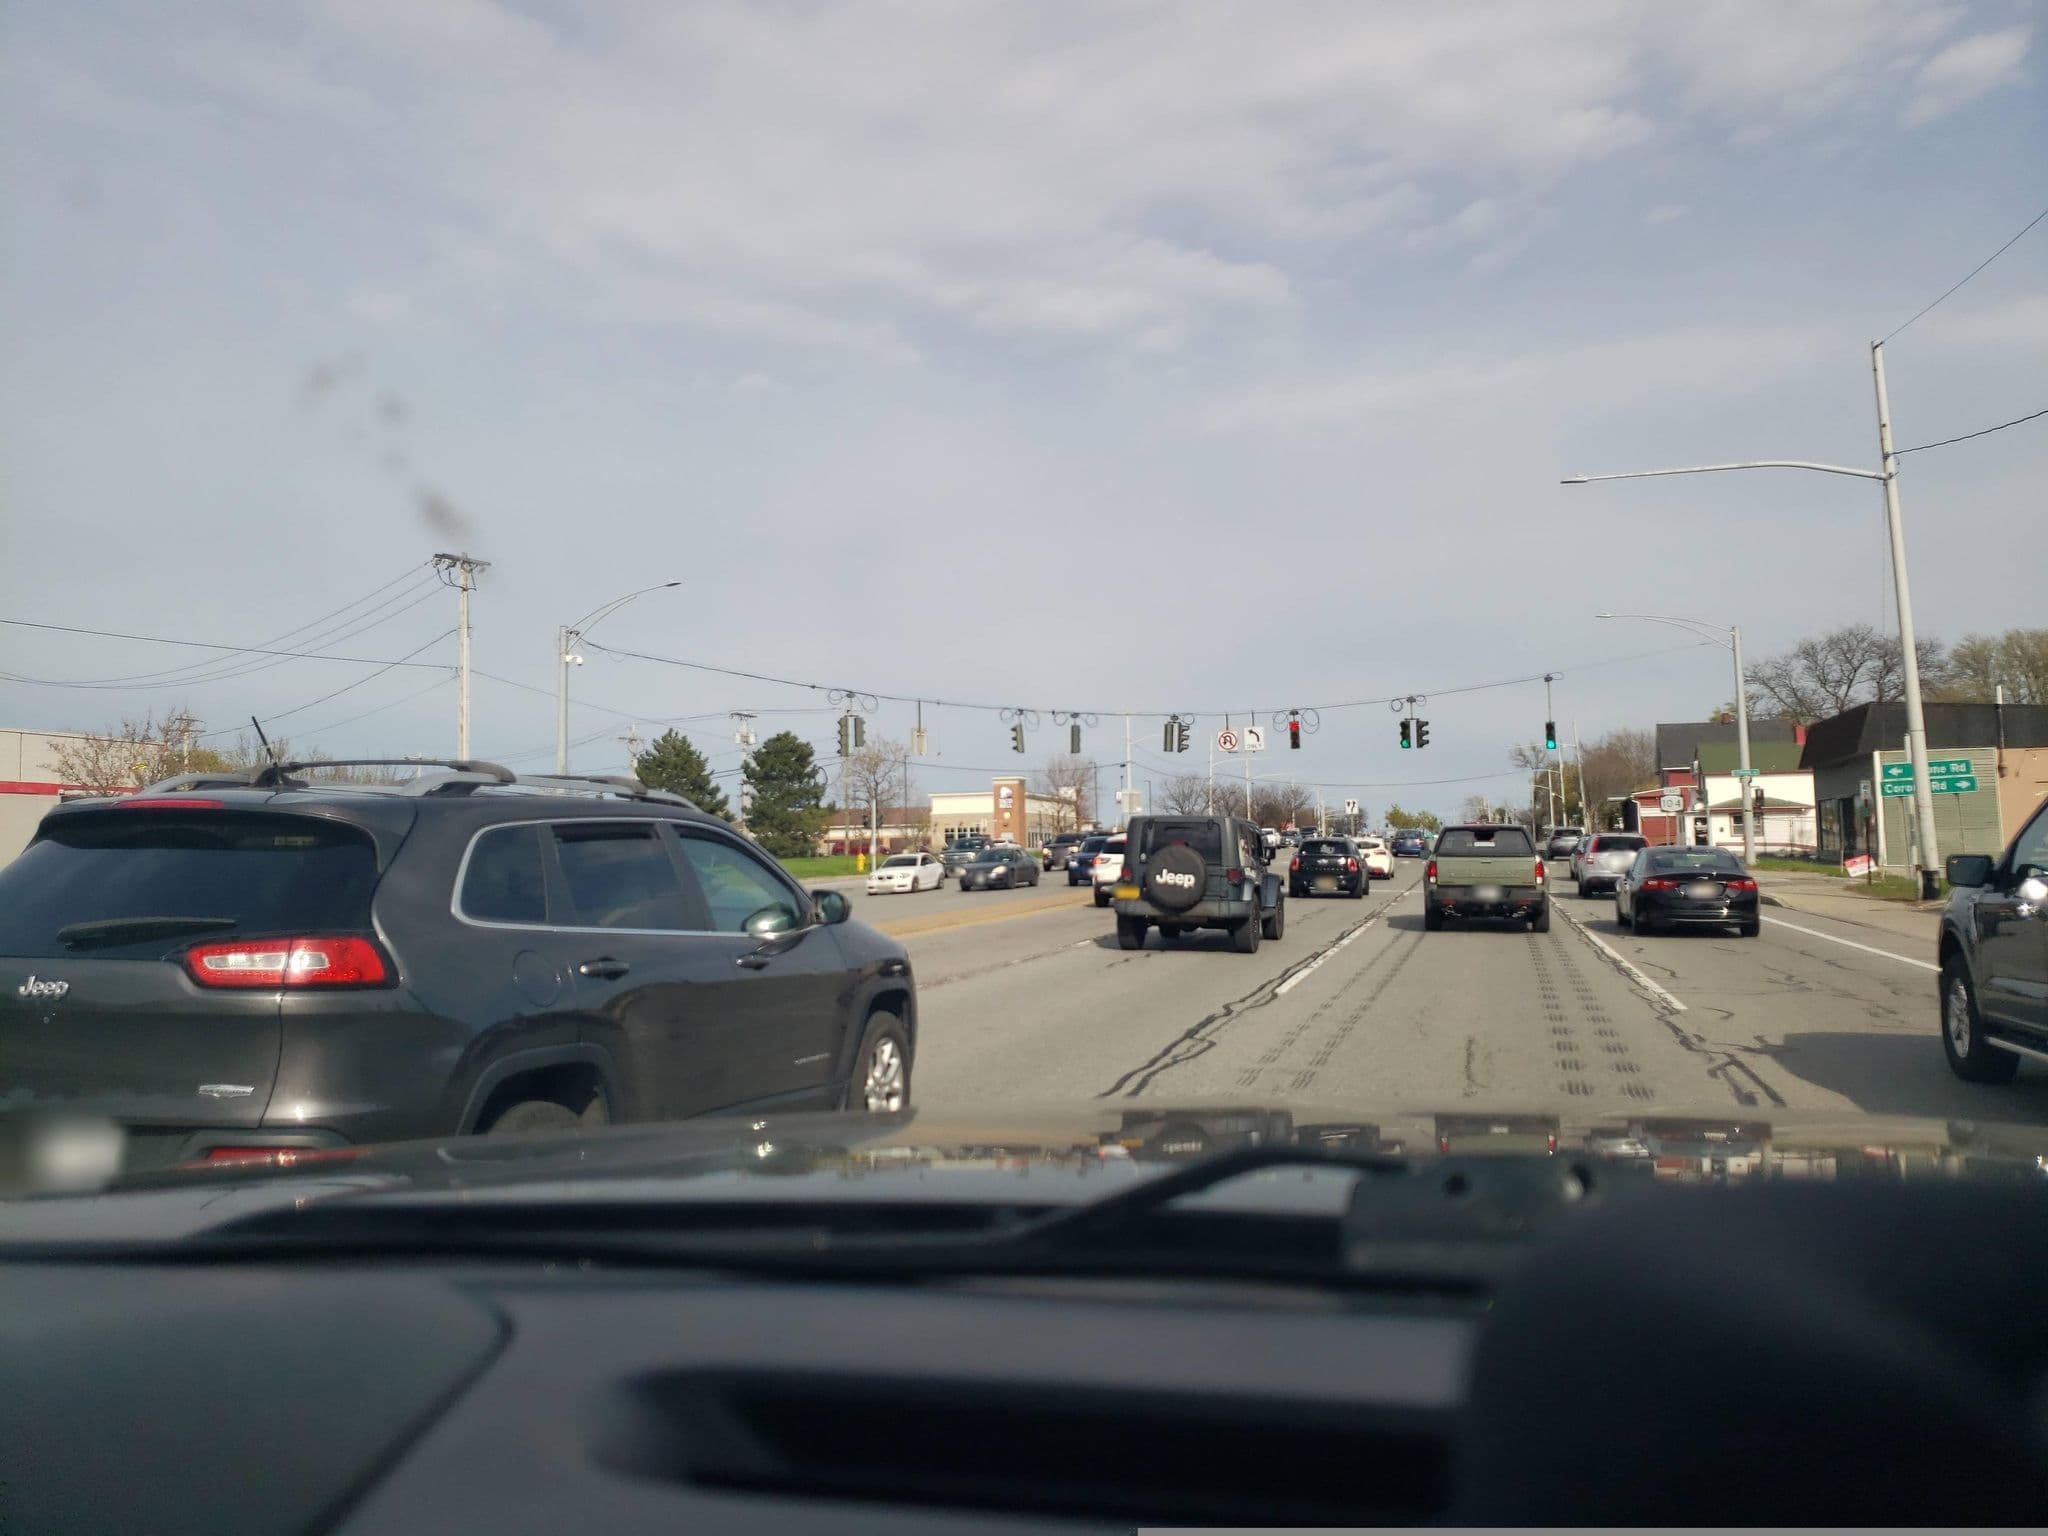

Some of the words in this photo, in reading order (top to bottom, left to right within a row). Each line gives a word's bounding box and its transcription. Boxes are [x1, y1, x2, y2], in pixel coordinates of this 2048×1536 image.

[1949, 762, 1966, 773] Rd
[1931, 779, 1947, 791] Rd
[1662, 798, 1682, 807] 104
[1155, 868, 1196, 889] Jeep
[18, 975, 69, 993] Jeep
